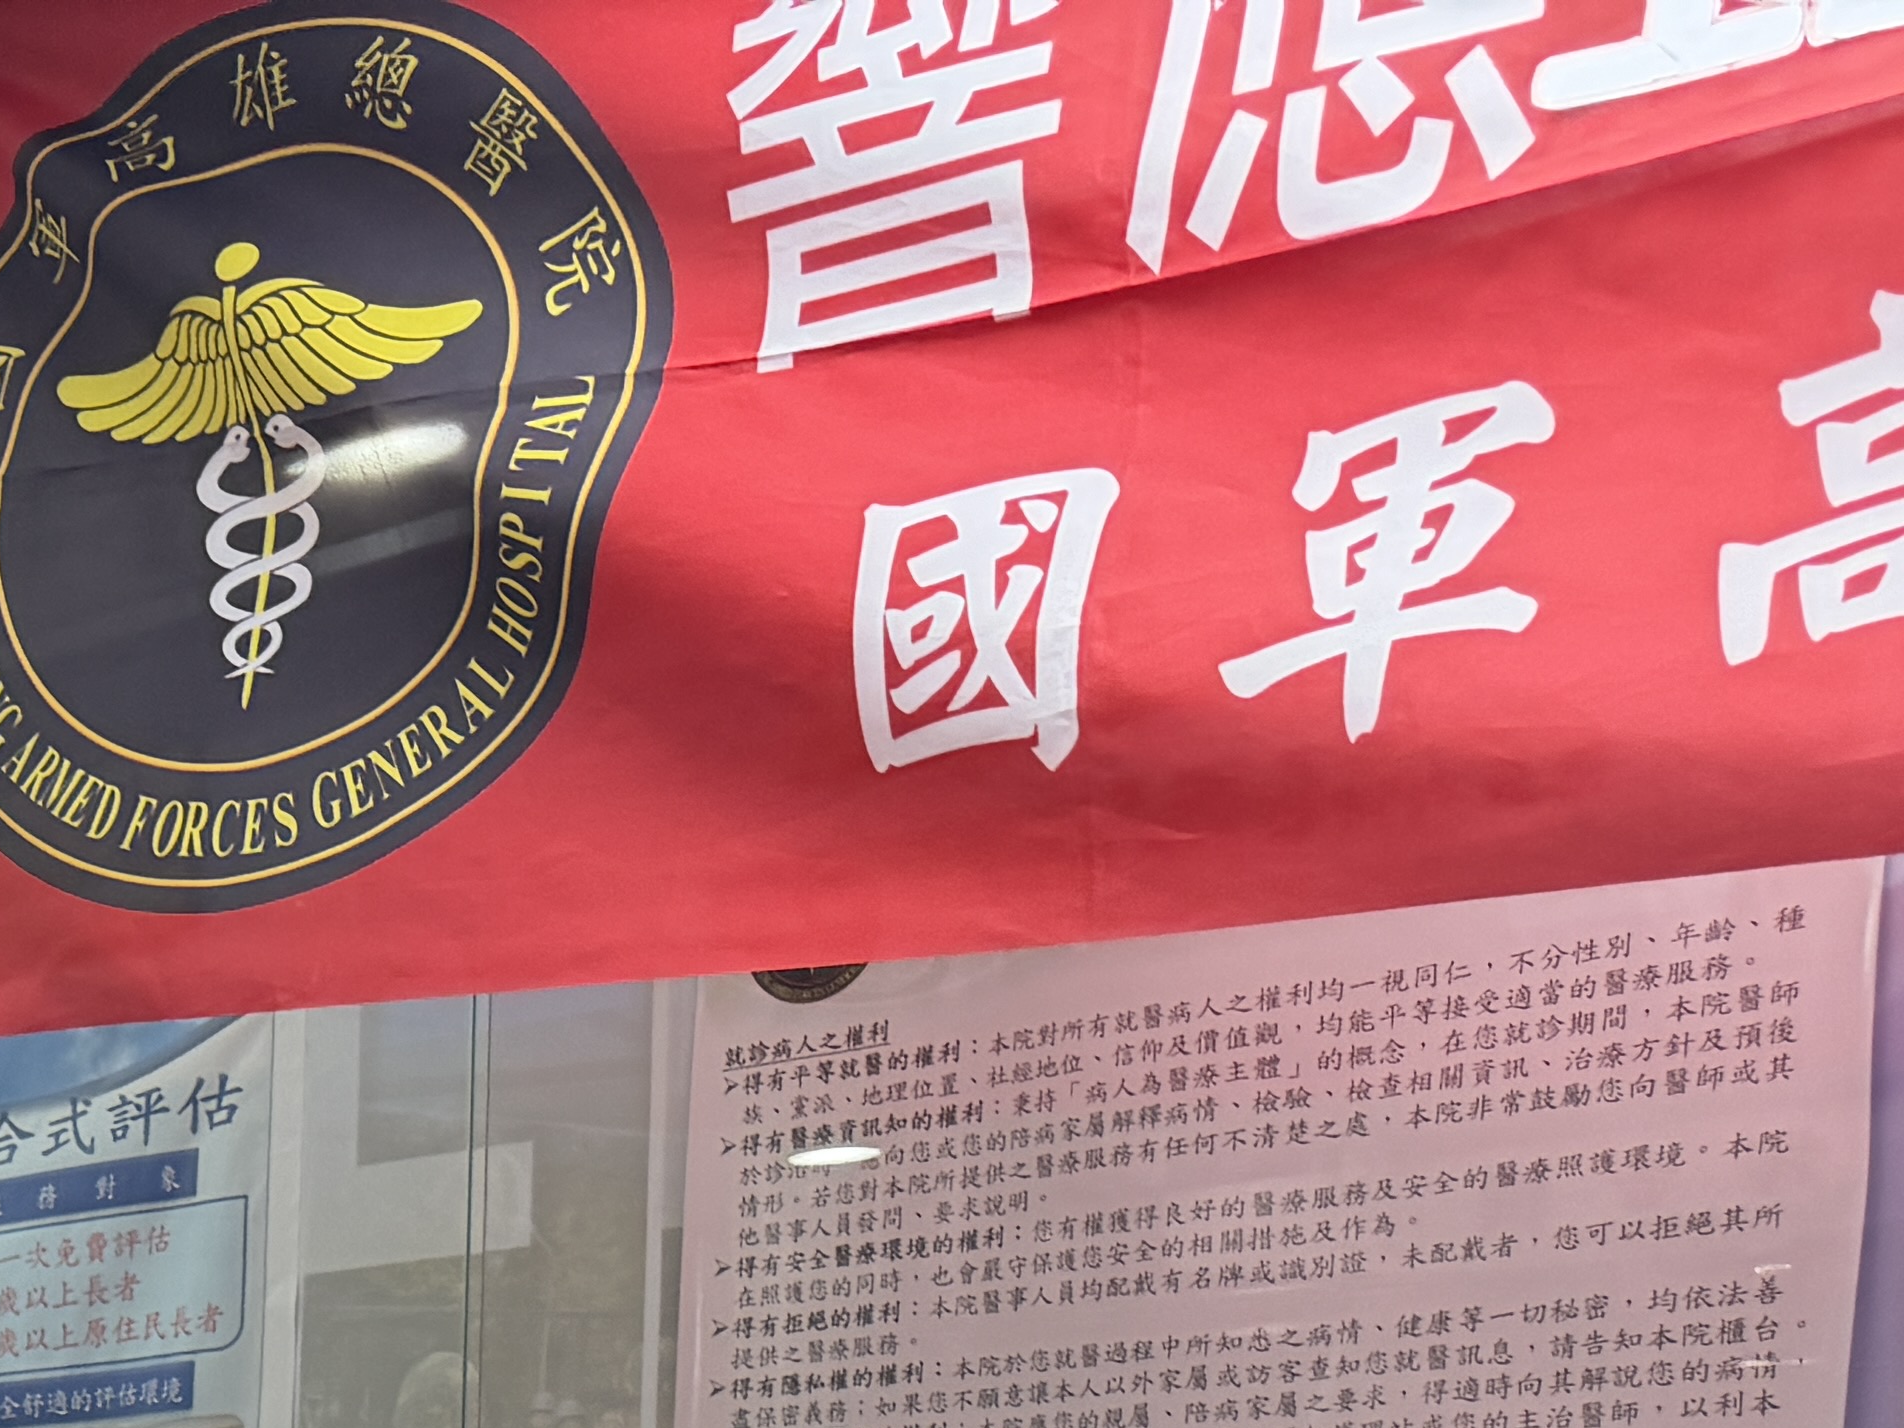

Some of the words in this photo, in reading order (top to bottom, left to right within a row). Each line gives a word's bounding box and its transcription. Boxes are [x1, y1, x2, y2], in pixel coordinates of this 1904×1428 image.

[1, 743, 121, 841] ARMED
[121, 792, 299, 858] FORCES
[312, 655, 514, 828] GENERAL
[488, 376, 594, 657] HOSPITAL
[724, 1019, 890, 1067] 就診病人之權利
[739, 1190, 1048, 1248] 他醫事人員發問、要求說明。
[731, 1333, 918, 1370] 提供之醫療服務。
